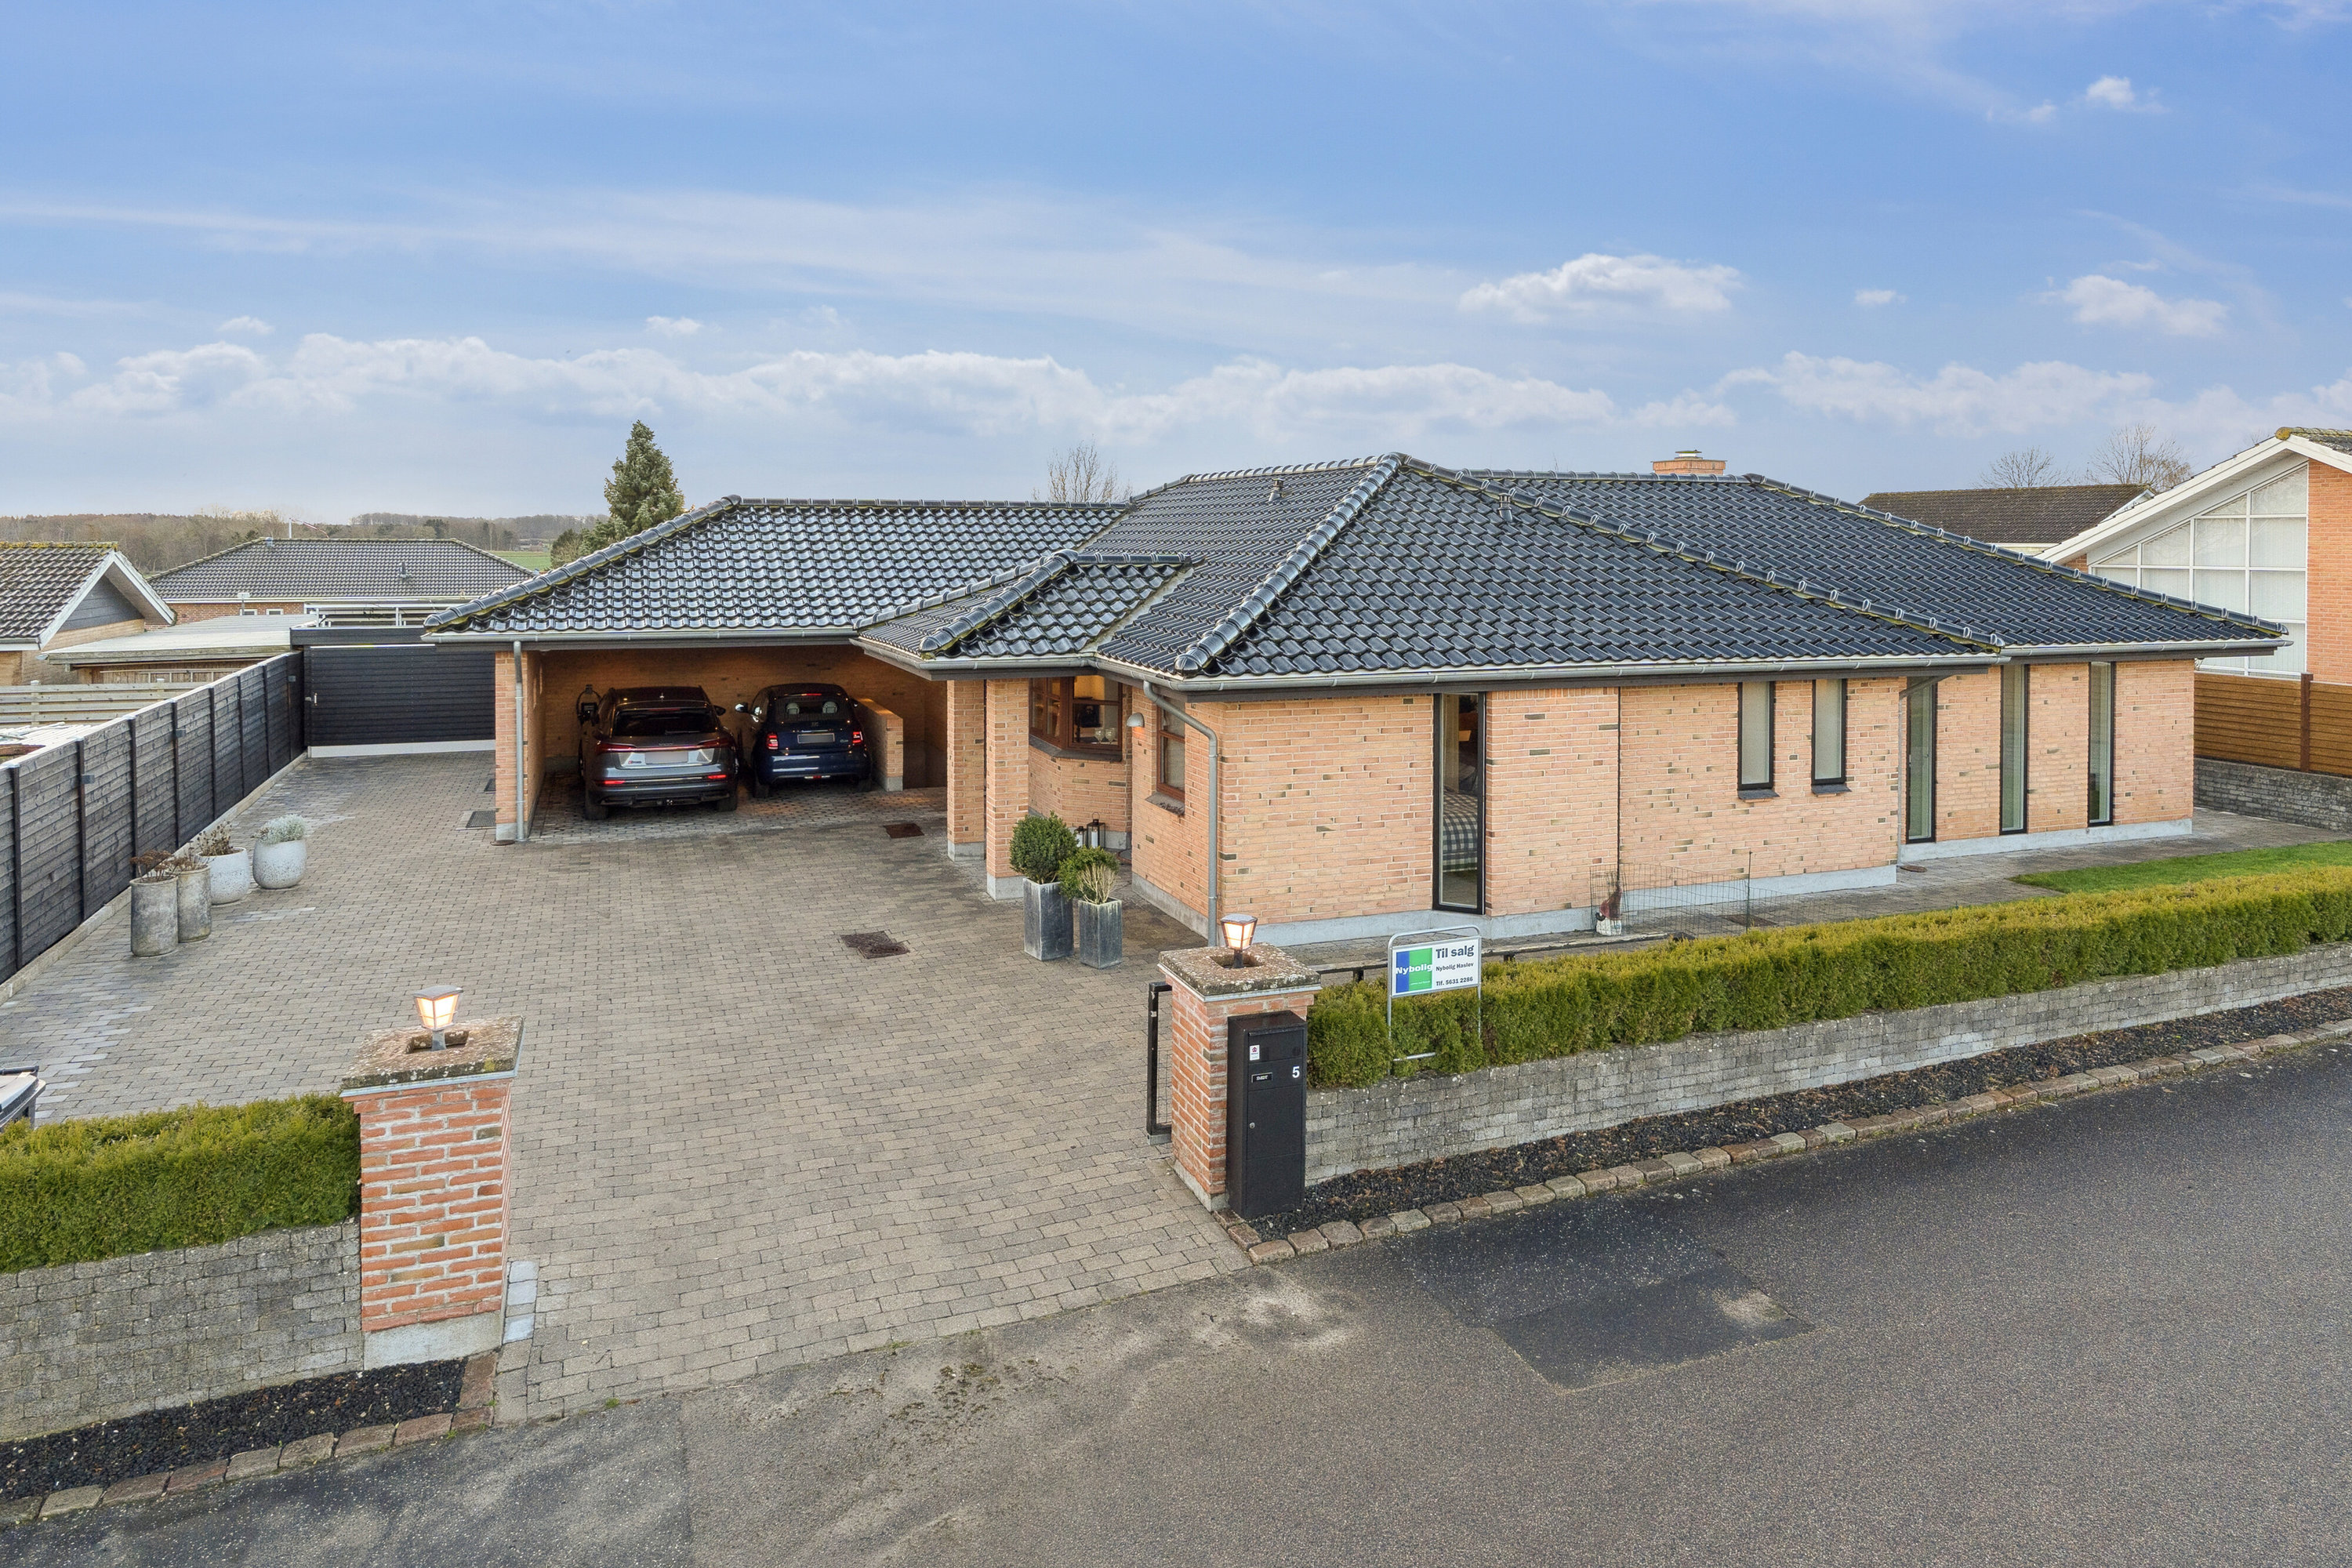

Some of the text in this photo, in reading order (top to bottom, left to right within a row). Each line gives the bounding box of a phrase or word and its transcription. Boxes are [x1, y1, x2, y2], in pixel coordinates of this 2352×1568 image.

[1436, 945, 1474, 958] Til salg
[1396, 964, 1432, 975] Nybolig
[1292, 1065, 1300, 1078] 5
